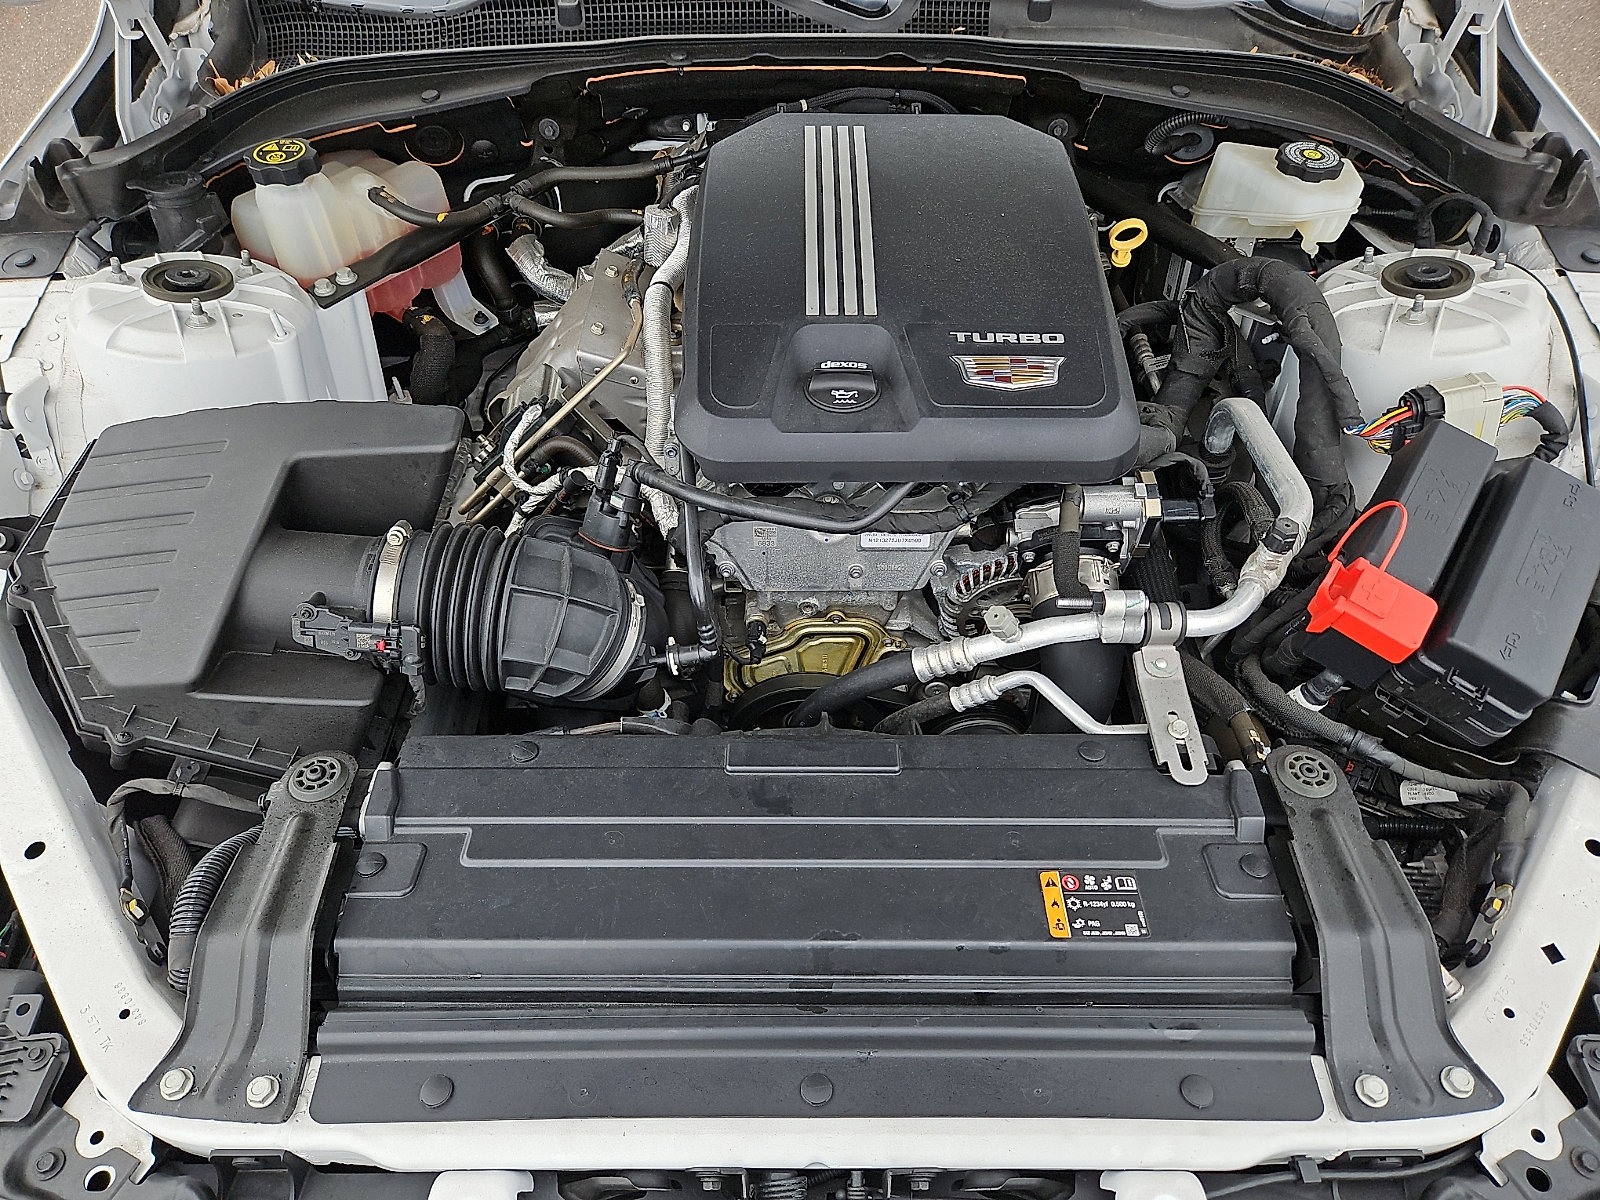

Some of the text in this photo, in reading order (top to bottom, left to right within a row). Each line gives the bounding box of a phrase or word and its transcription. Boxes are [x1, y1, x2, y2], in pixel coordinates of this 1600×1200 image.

[950, 332, 1065, 344] TURBO
[820, 361, 868, 369] dexos
[100, 1035, 114, 1053] TK
